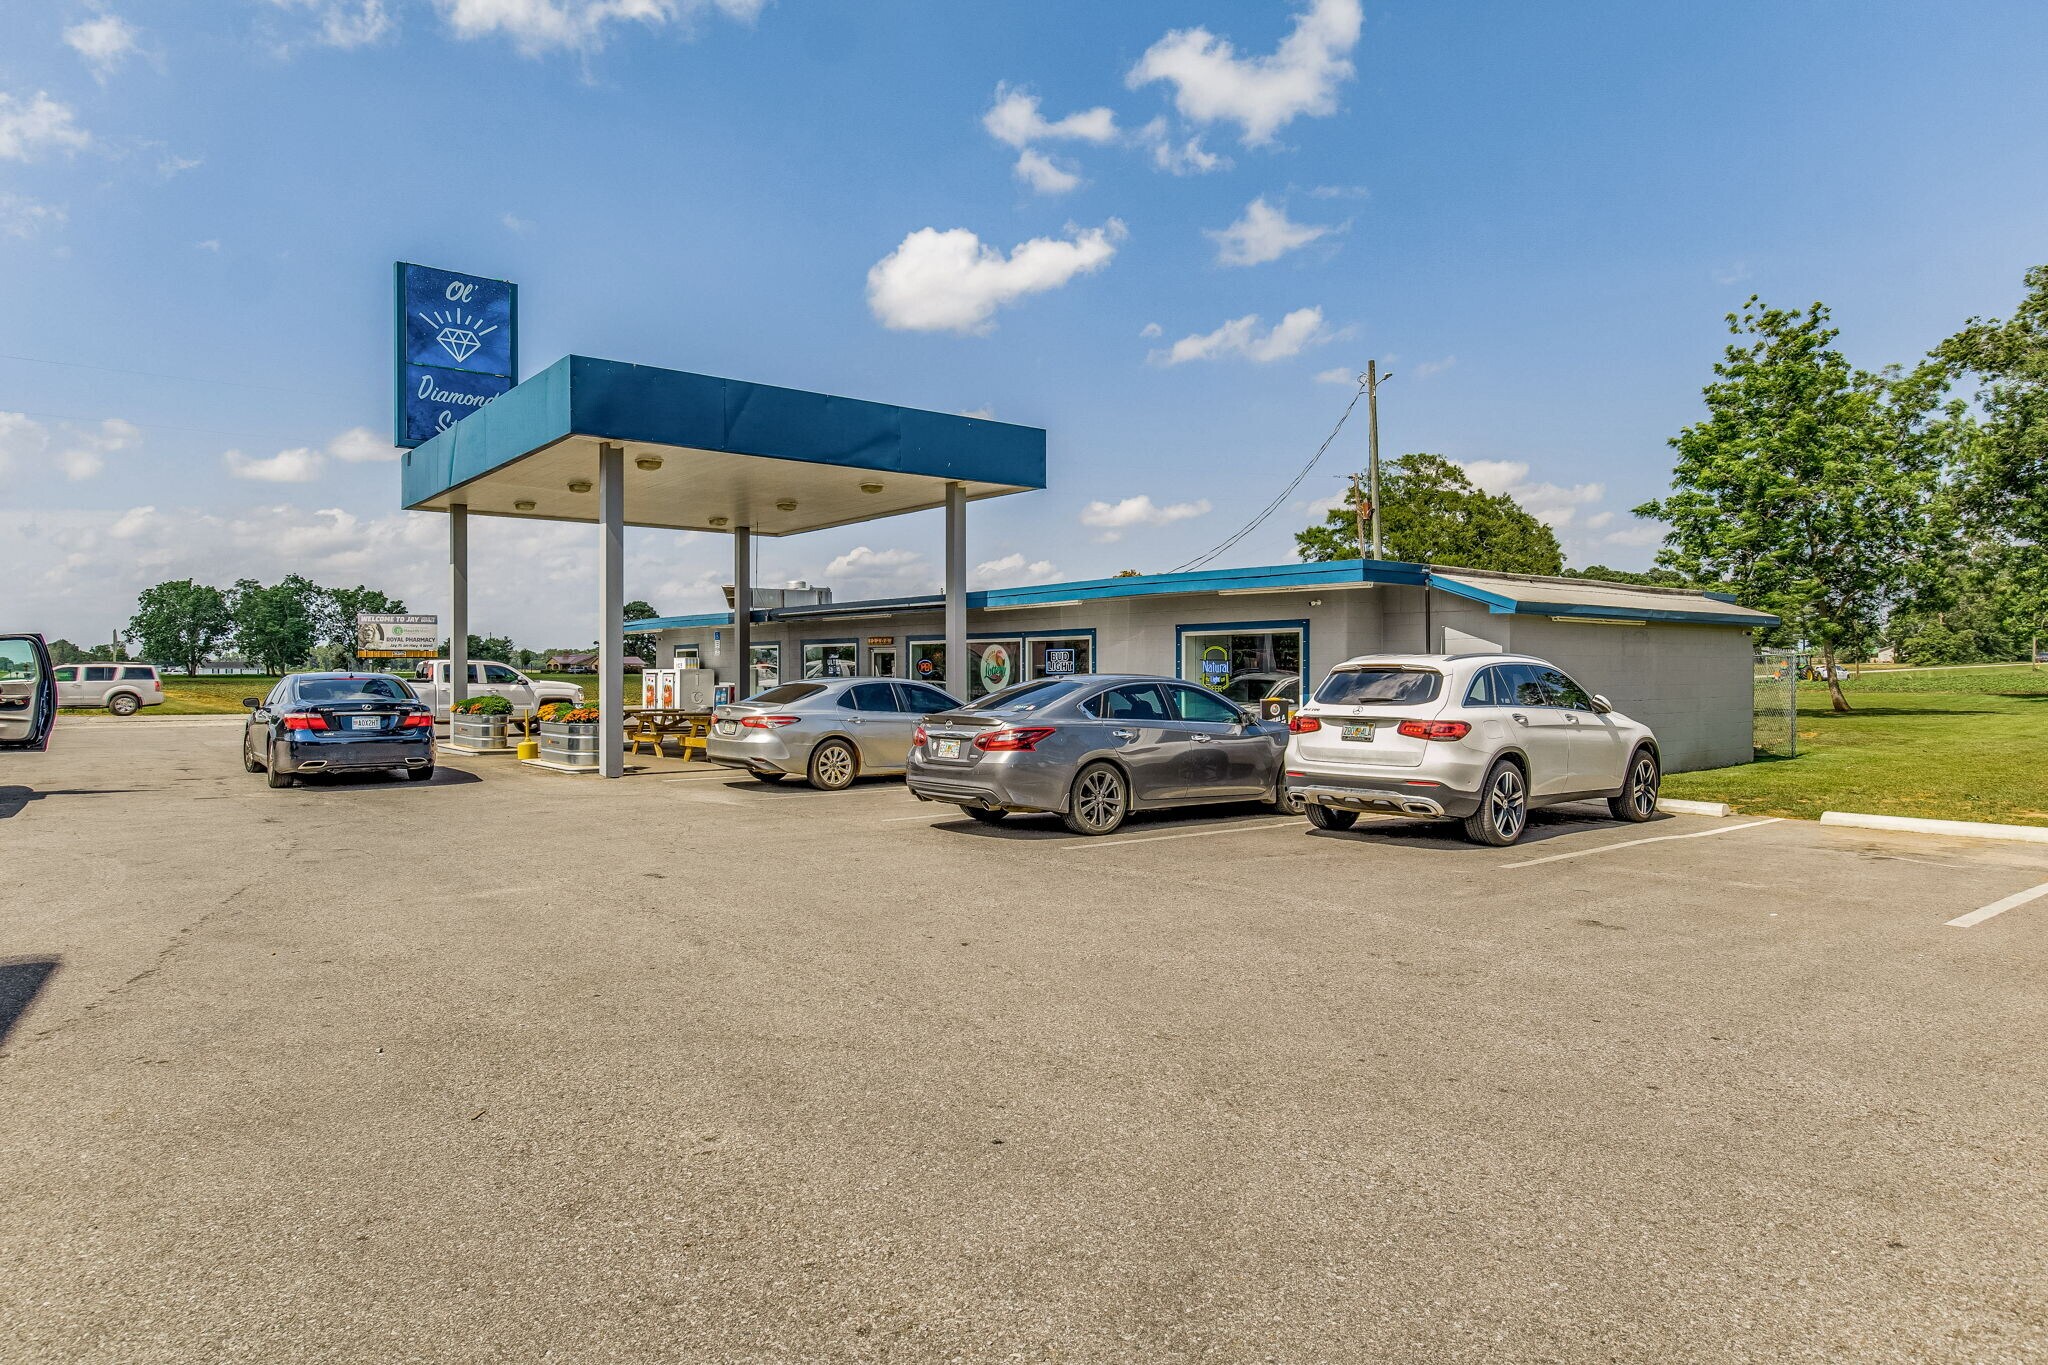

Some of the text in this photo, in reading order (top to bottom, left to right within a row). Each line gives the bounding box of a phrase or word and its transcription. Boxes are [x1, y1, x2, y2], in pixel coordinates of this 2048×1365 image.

[445, 280, 479, 303] Ol'
[1050, 651, 1070, 662] BUD
[984, 662, 1007, 679] Lottery
[1047, 661, 1073, 672] LIGHT
[1202, 660, 1229, 673] Natural
